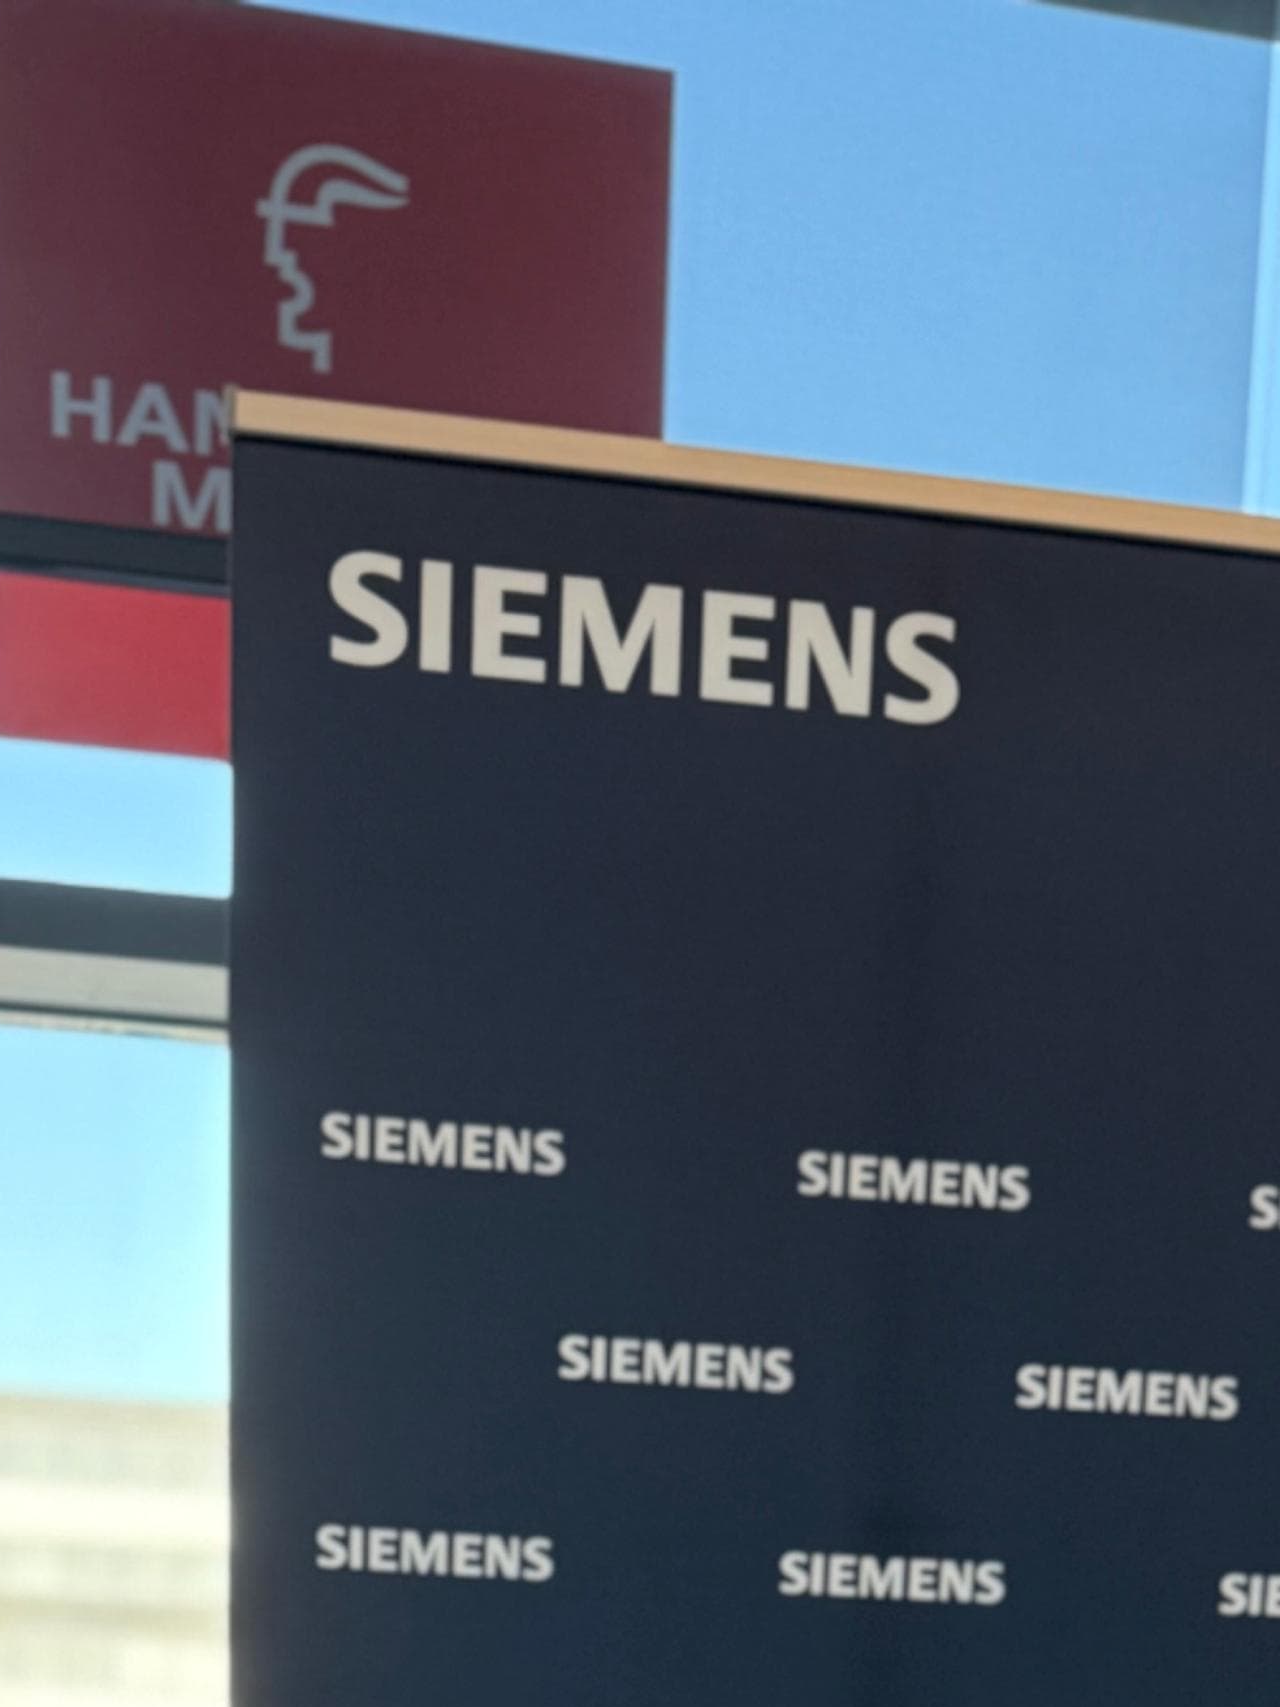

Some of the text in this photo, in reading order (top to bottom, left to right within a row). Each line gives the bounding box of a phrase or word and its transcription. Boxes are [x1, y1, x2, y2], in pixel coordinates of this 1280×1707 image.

[328, 550, 961, 725] SIEMENS
[320, 1111, 566, 1176] SIEMENS
[796, 1150, 1031, 1211] SIEMENS
[557, 1334, 794, 1393] SIEMENS
[1014, 1364, 1239, 1420] SIEMENS
[315, 1524, 555, 1581] SIEMENS
[778, 1551, 1007, 1605] SIEMENS
